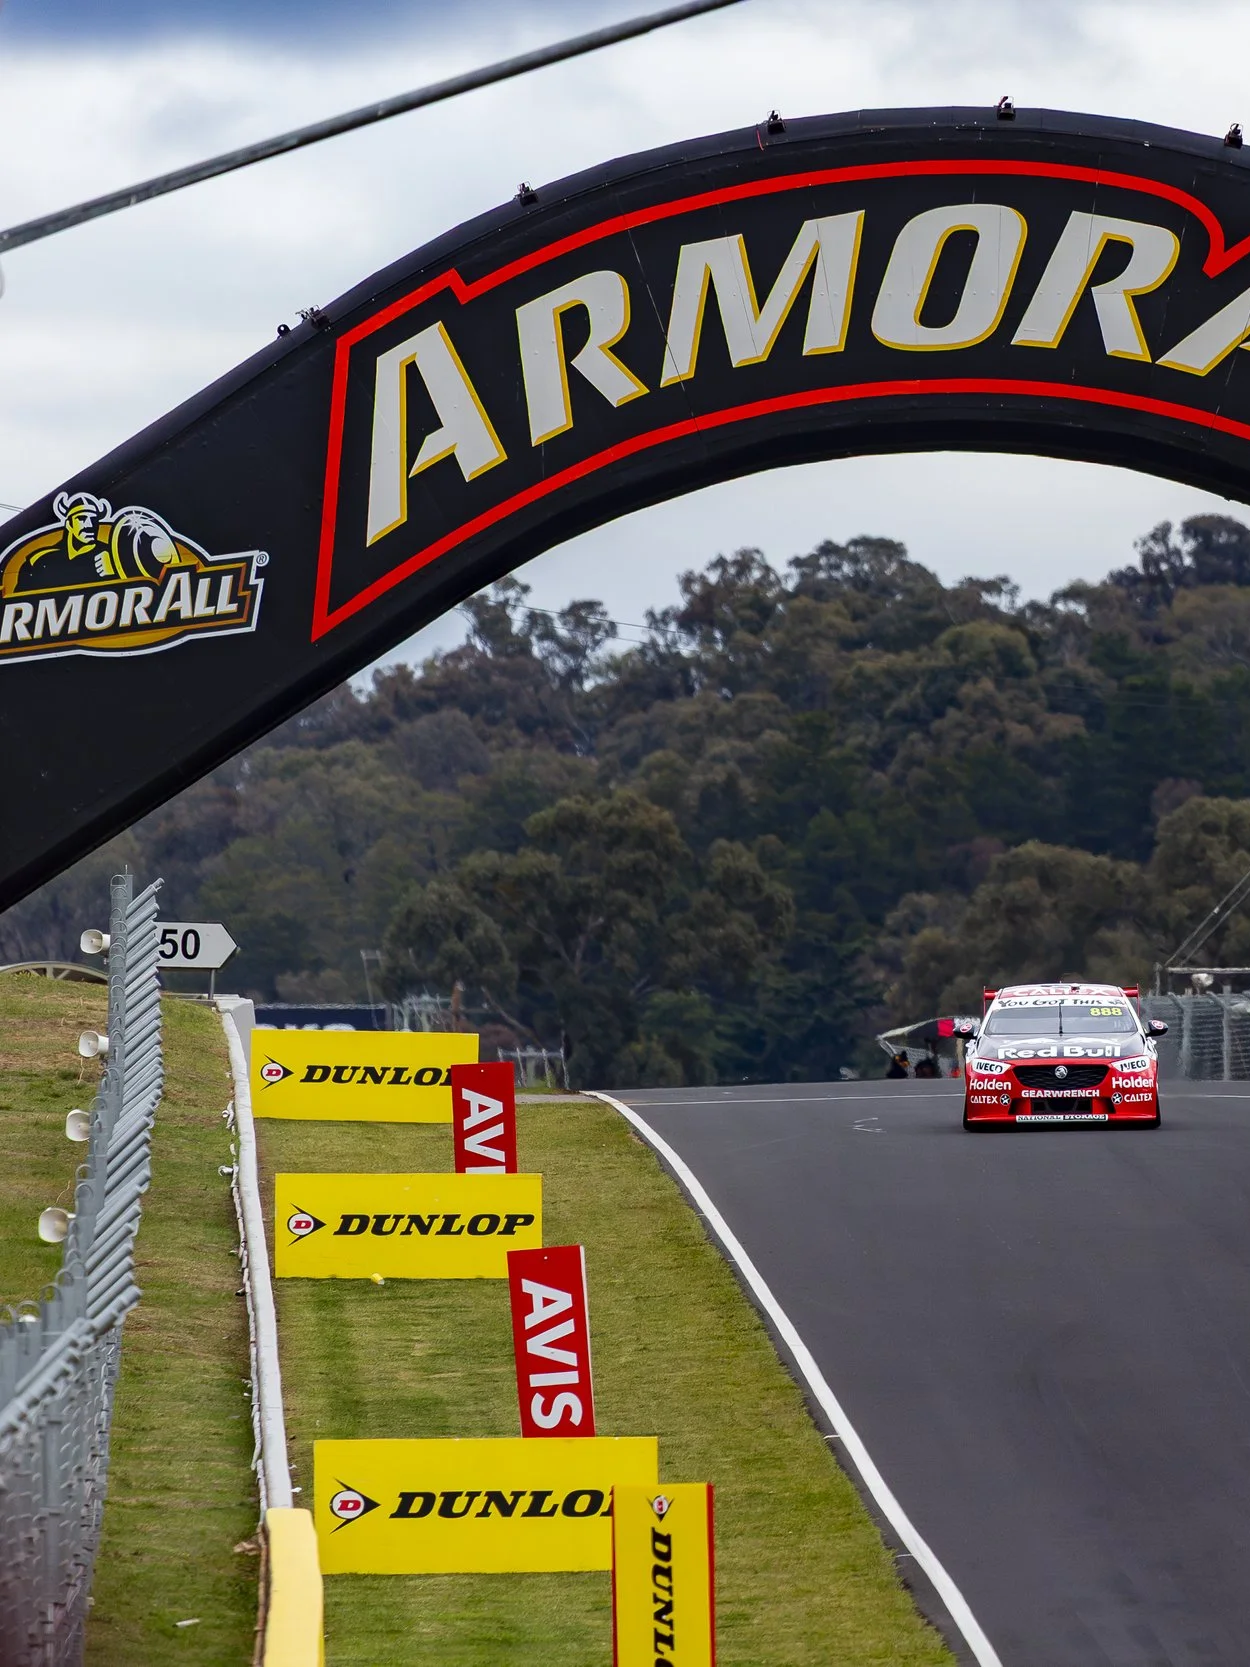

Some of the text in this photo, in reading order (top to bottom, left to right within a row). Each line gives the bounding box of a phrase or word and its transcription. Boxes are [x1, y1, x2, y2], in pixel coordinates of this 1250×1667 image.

[0, 571, 239, 643] RMORALL
[1090, 1007, 1122, 1016] 888
[997, 1045, 1121, 1059] Red Bull
[976, 1062, 1003, 1073] IVECO
[1120, 1059, 1147, 1072] IVECO
[970, 1078, 1012, 1091] Holden
[1112, 1076, 1154, 1089] Holden
[970, 1095, 998, 1104] CALTEX
[1021, 1089, 1100, 1098] GEARWRENCH
[1124, 1092, 1153, 1102] CALTEX
[462, 1088, 506, 1173] AVI
[333, 1213, 535, 1236] DUNLOP
[520, 1278, 582, 1429] AVIS
[651, 1526, 675, 1667] DUNL
